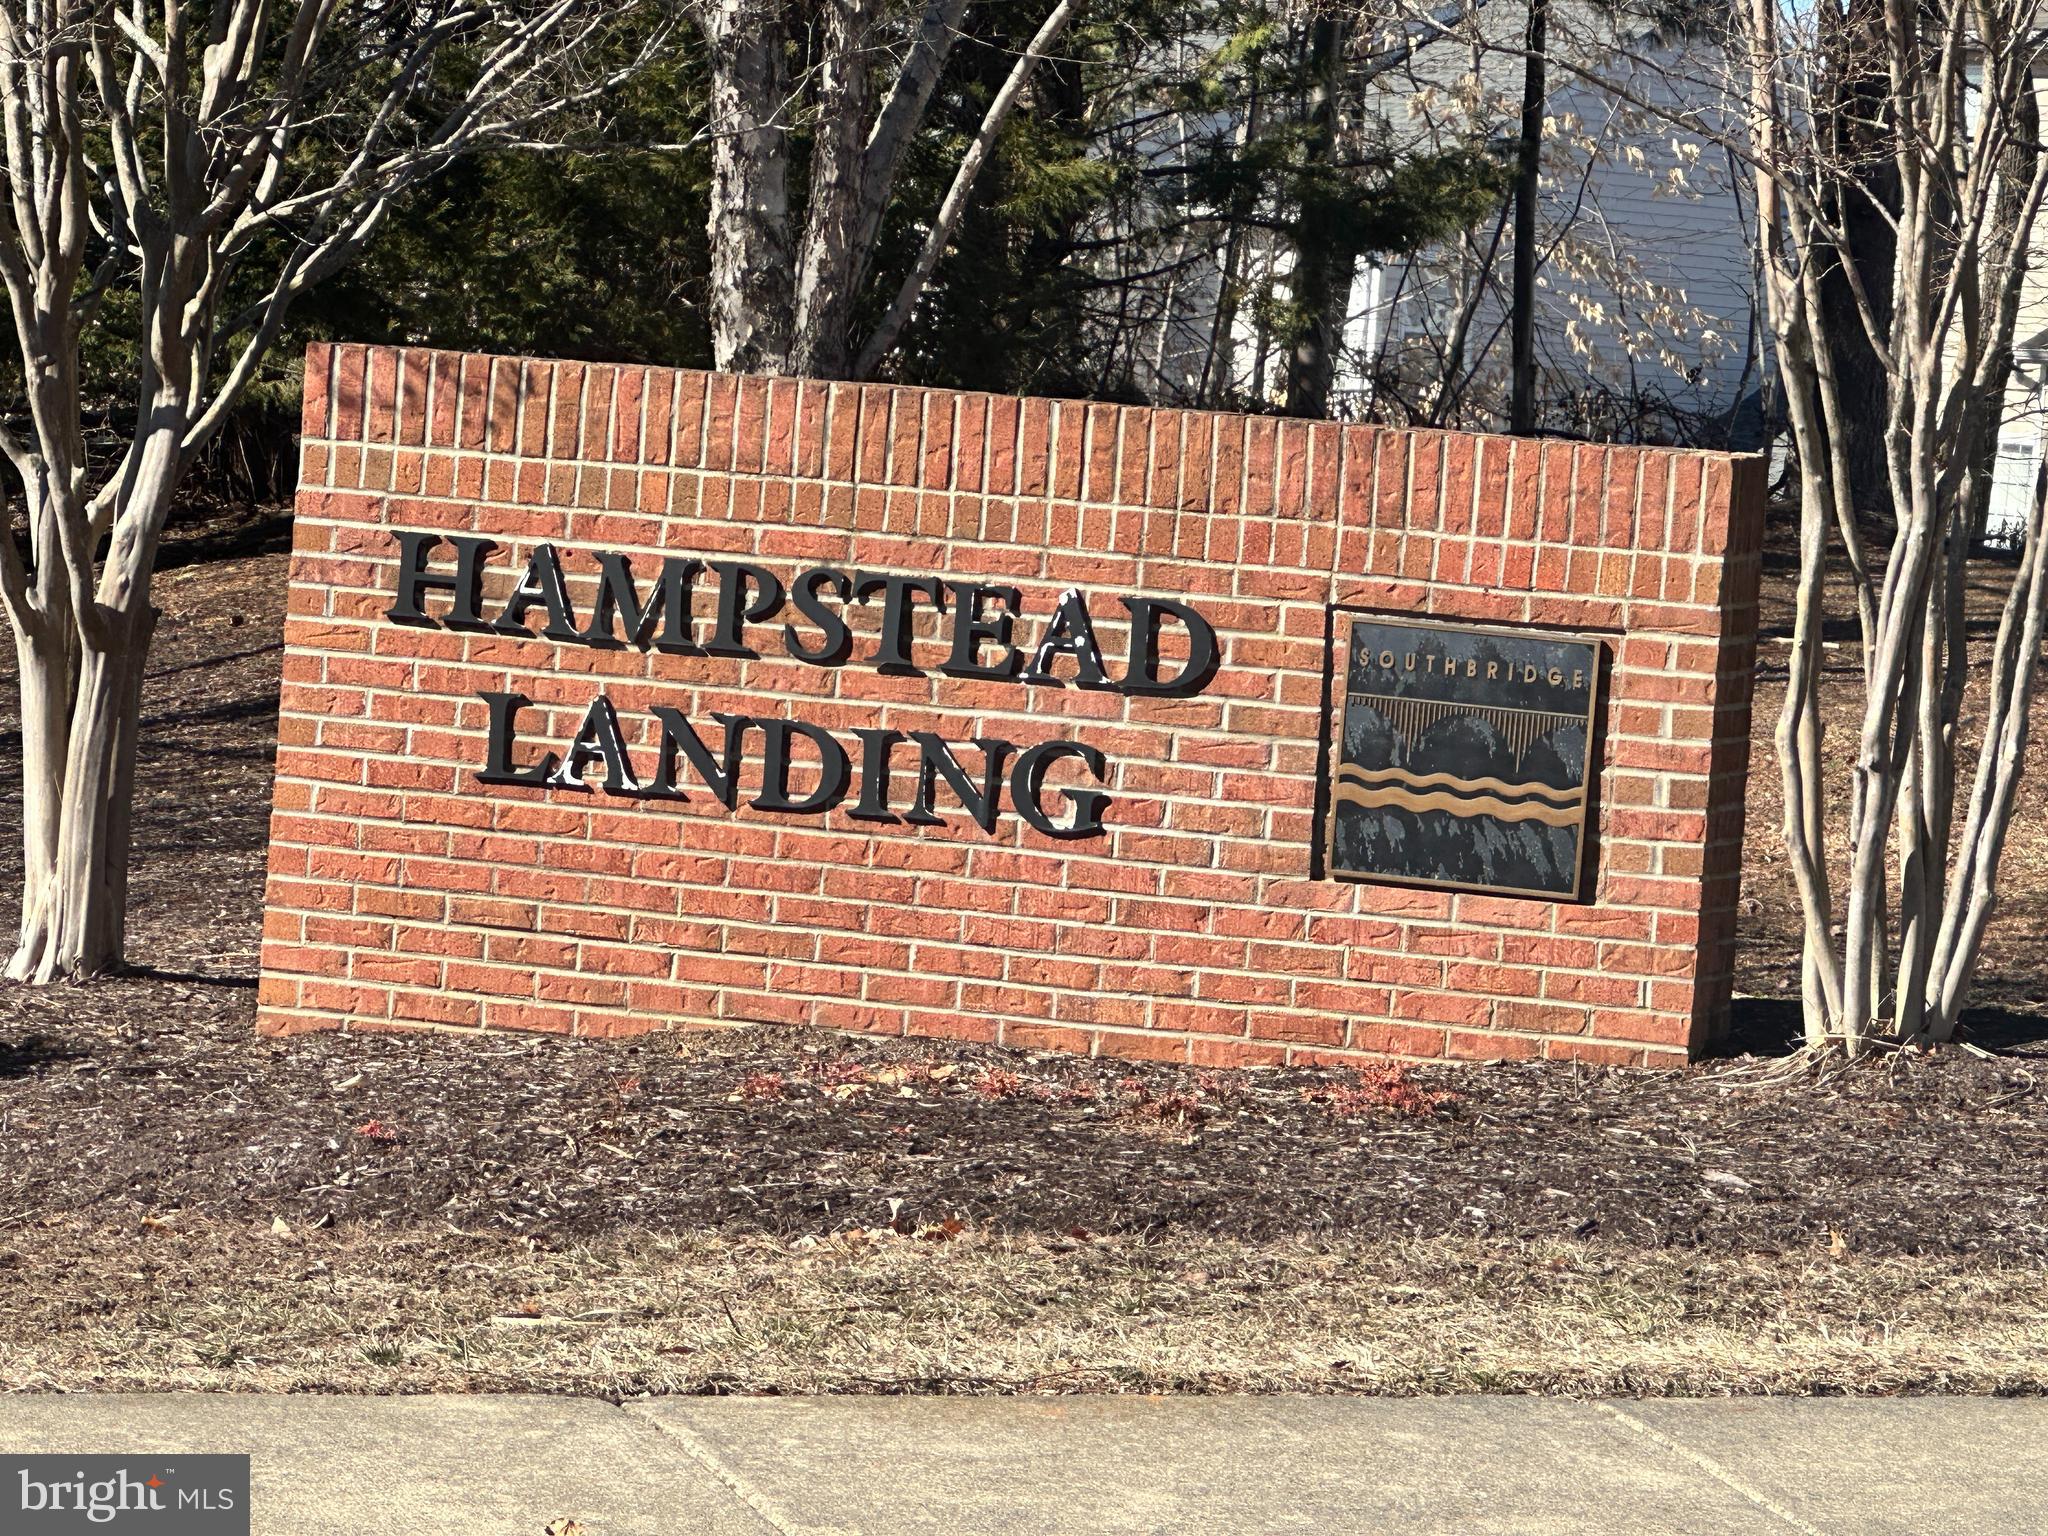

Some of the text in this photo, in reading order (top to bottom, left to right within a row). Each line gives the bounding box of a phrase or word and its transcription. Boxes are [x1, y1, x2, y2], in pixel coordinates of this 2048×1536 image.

[385, 530, 1220, 697] HAMPSTEAD
[1358, 647, 1584, 689] SOUTHBRIDGE
[475, 691, 1111, 840] LANDING
